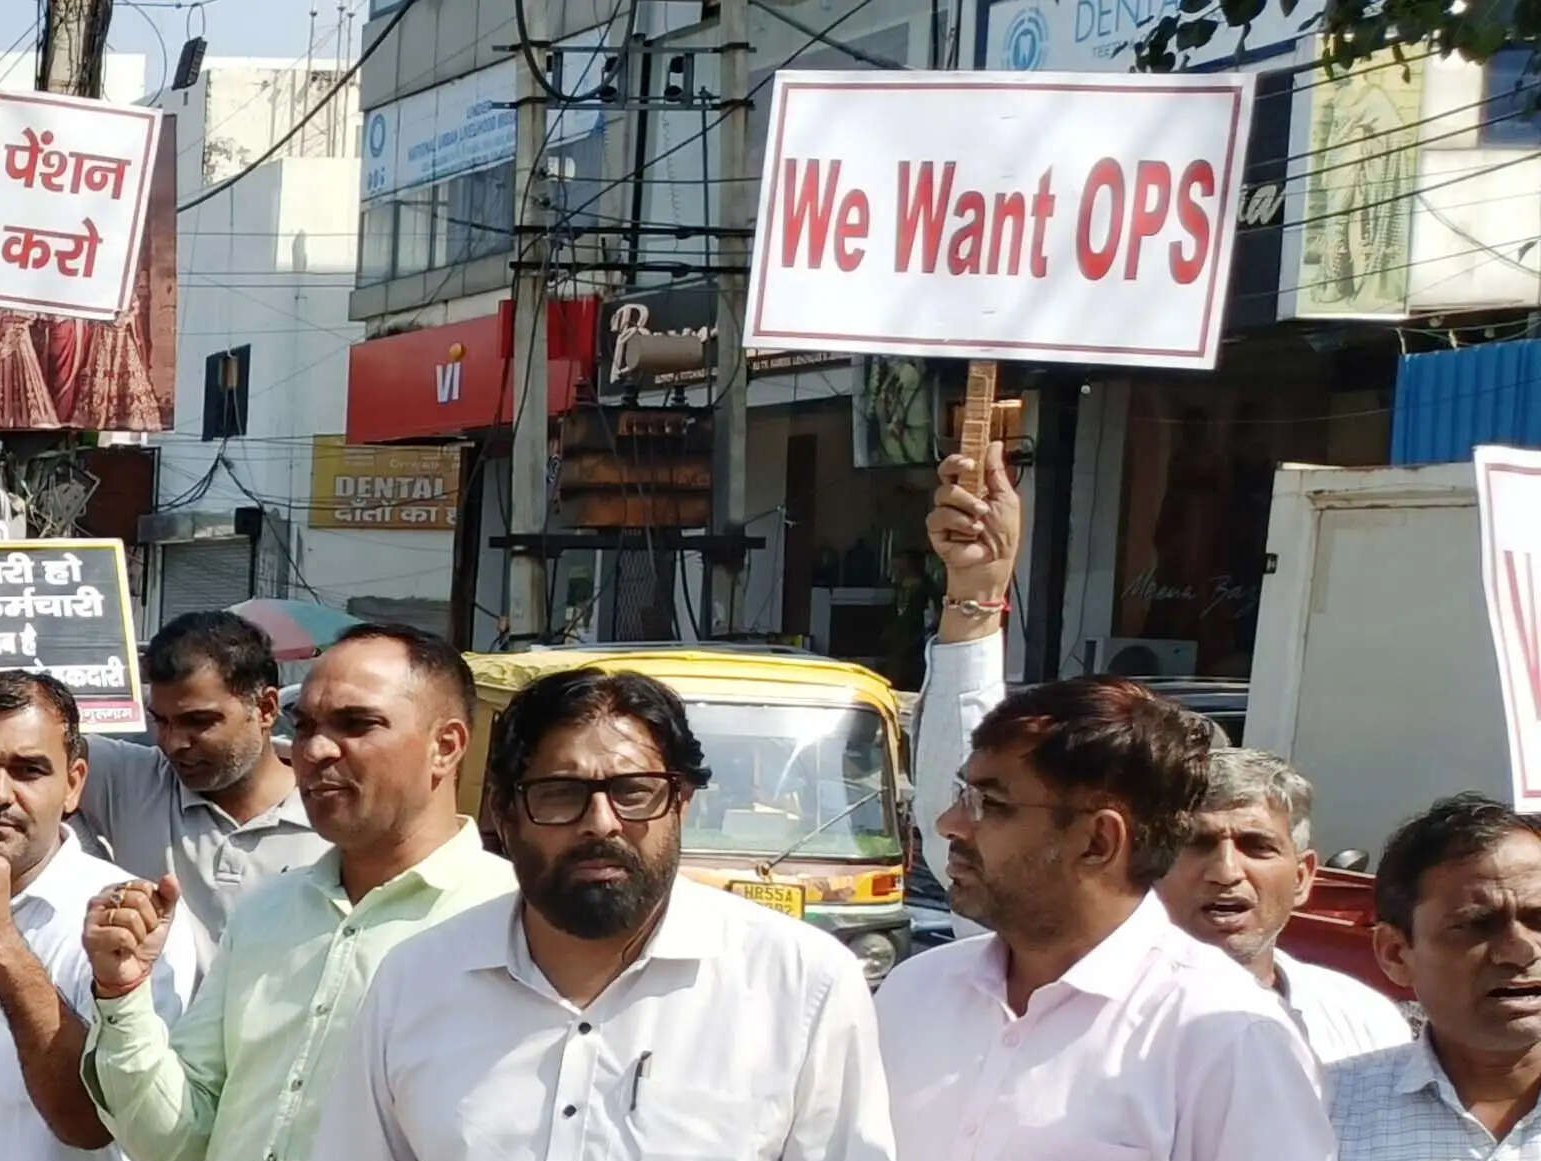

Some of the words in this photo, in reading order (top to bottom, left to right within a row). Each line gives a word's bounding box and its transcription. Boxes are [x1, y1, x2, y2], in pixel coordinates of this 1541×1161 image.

[5, 127, 132, 200] पेंशन
[781, 158, 870, 272] We
[894, 160, 1056, 278] Want
[1076, 157, 1215, 285] OPS
[2, 217, 104, 279] करो
[333, 475, 448, 499] DENTAL
[41, 552, 84, 586] हो
[20, 622, 38, 657] है
[744, 884, 794, 903] HR55A
